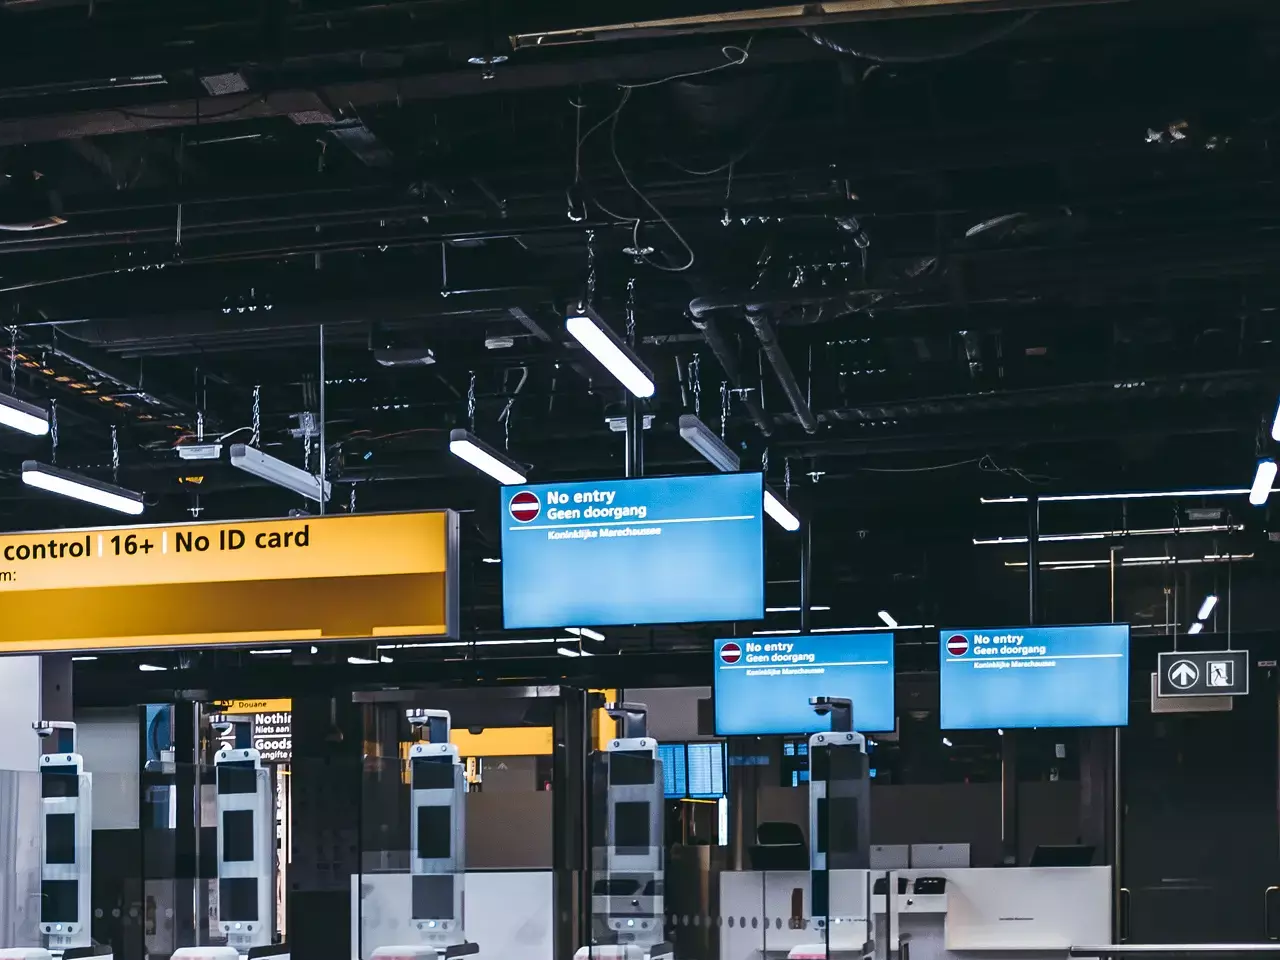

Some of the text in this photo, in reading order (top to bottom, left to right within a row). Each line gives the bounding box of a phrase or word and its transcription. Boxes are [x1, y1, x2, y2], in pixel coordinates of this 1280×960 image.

[547, 490, 616, 504] No entry
[547, 506, 647, 519] Geen doorgang
[4, 535, 91, 561] control
[110, 534, 154, 556] 16+
[175, 532, 209, 553] No
[220, 529, 246, 551] ID
[255, 525, 310, 548] card
[973, 635, 1023, 645] No entry
[746, 642, 794, 652] No entry
[973, 645, 1046, 655] Geen doorgang
[746, 653, 815, 663] Geen doorgang
[255, 738, 292, 750] Goods
